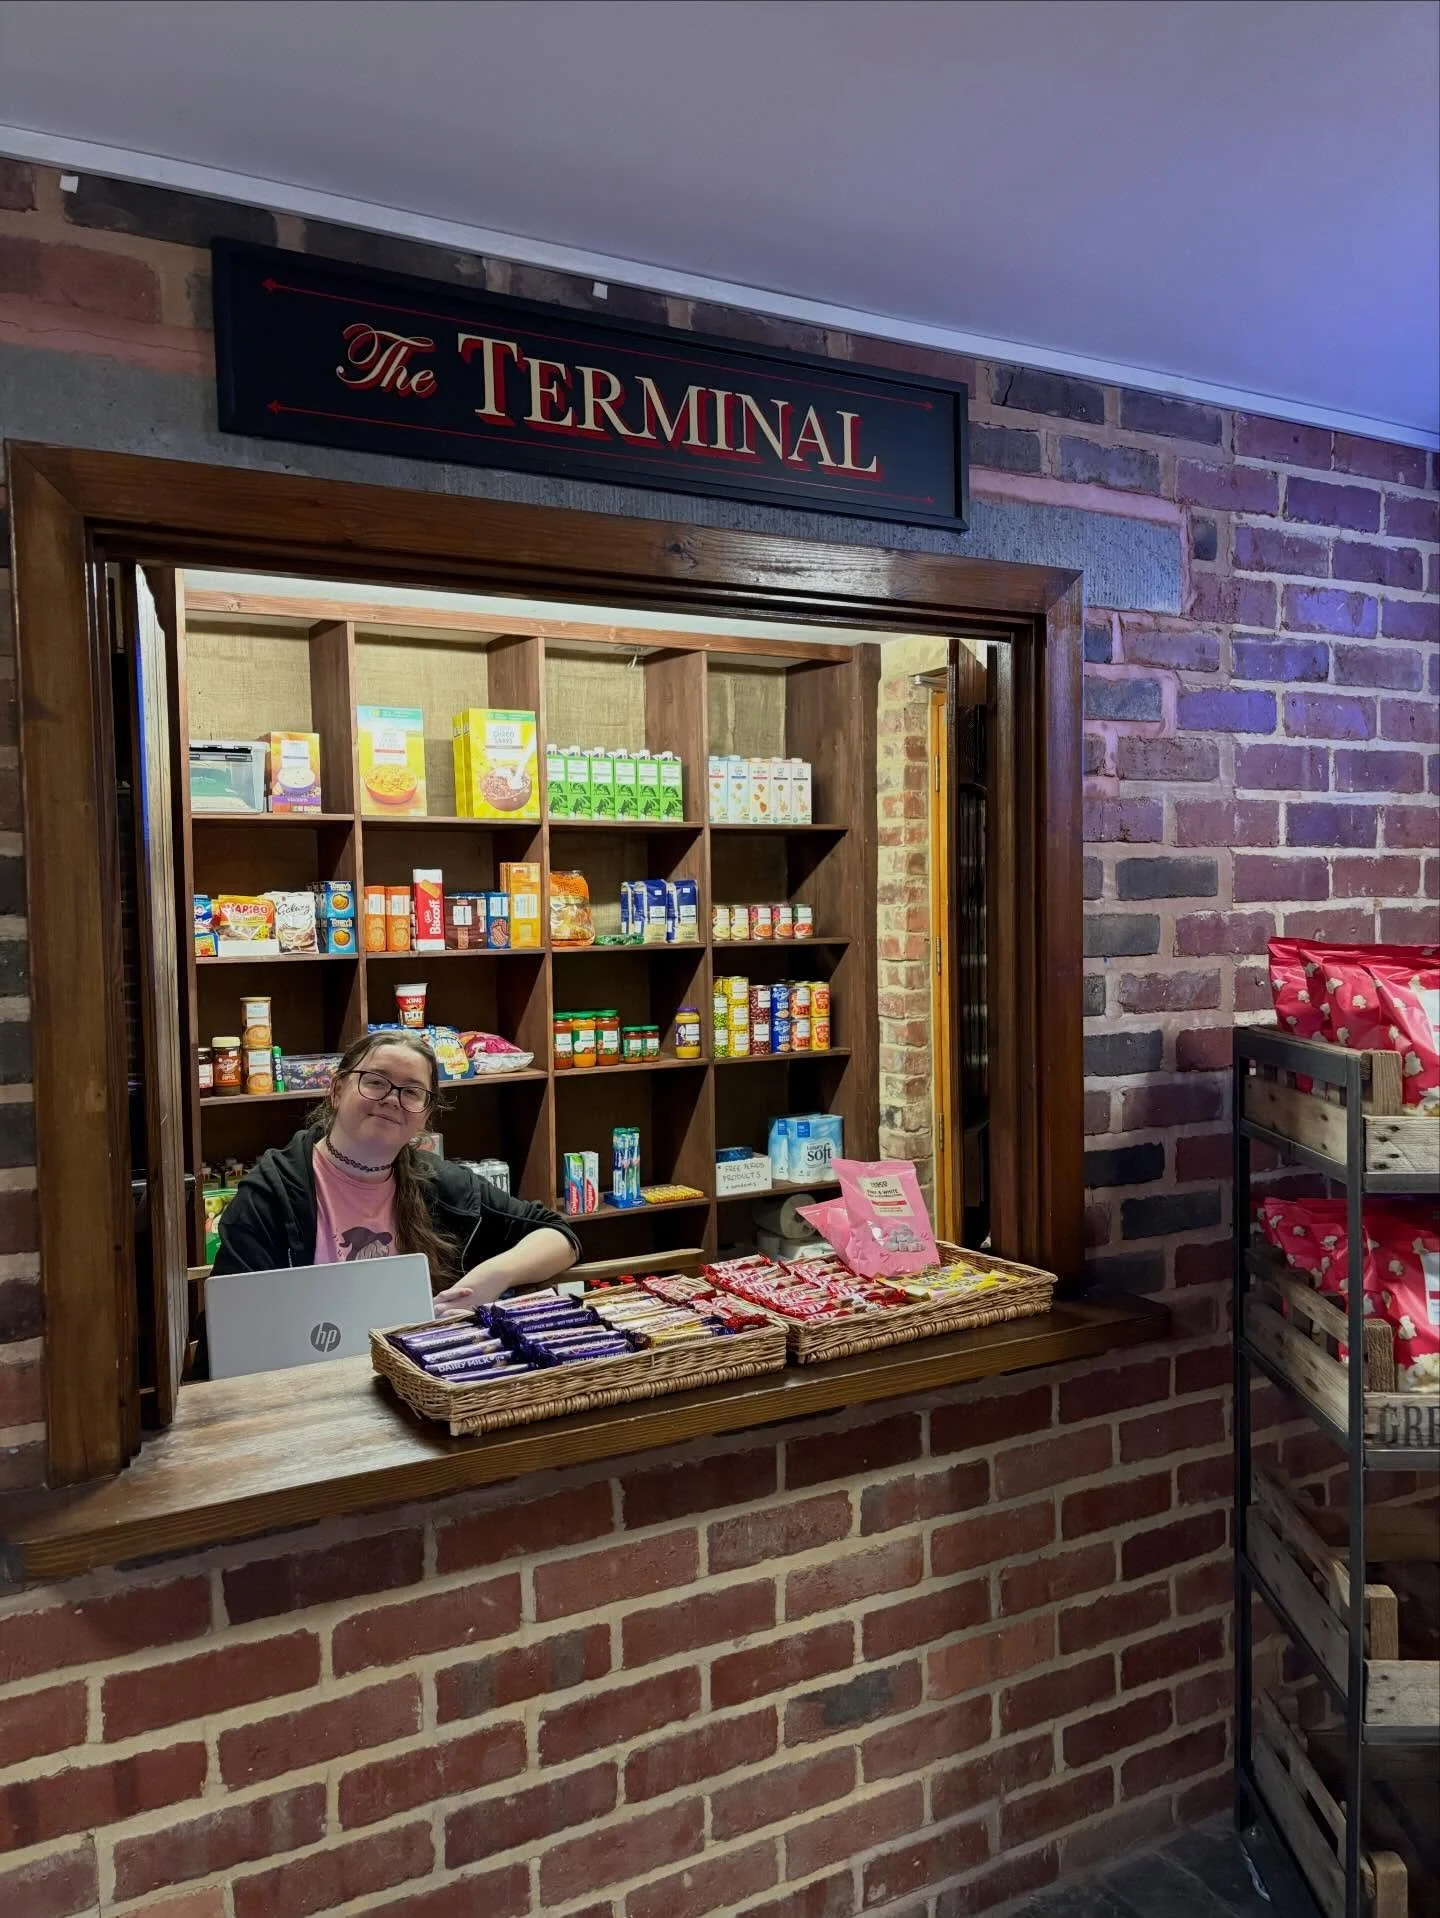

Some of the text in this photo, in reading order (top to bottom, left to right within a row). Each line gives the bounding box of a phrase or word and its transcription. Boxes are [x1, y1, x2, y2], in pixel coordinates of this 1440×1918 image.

[335, 322, 883, 482] The TERMINAL
[277, 903, 310, 915] Galaxy
[429, 899, 441, 935] Biscoff
[807, 1142, 832, 1165] soft
[586, 1185, 594, 1213] Colgate
[316, 1321, 338, 1352] hp
[438, 1362, 467, 1373] DAIRY
